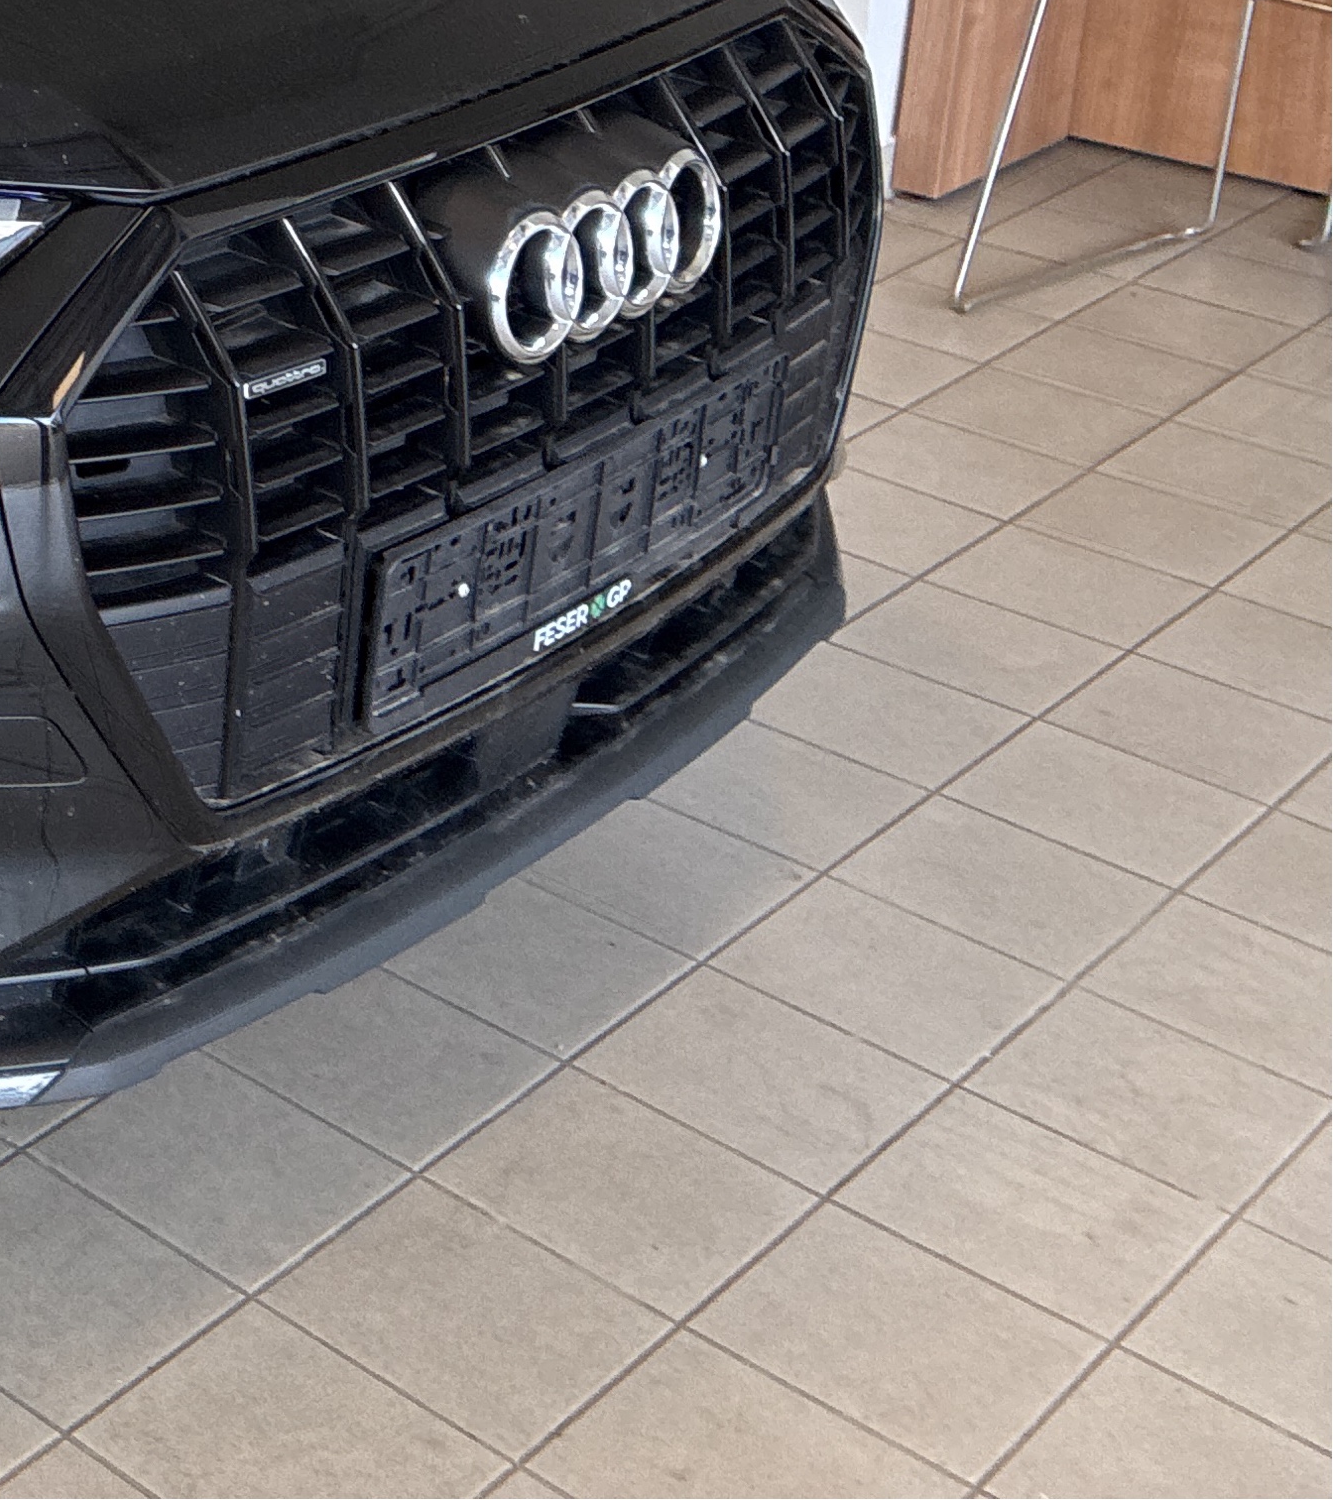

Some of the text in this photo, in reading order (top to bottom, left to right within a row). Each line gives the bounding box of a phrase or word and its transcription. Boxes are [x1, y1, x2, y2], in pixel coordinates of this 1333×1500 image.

[251, 363, 322, 395] quattro
[533, 579, 632, 651] FESER GP
